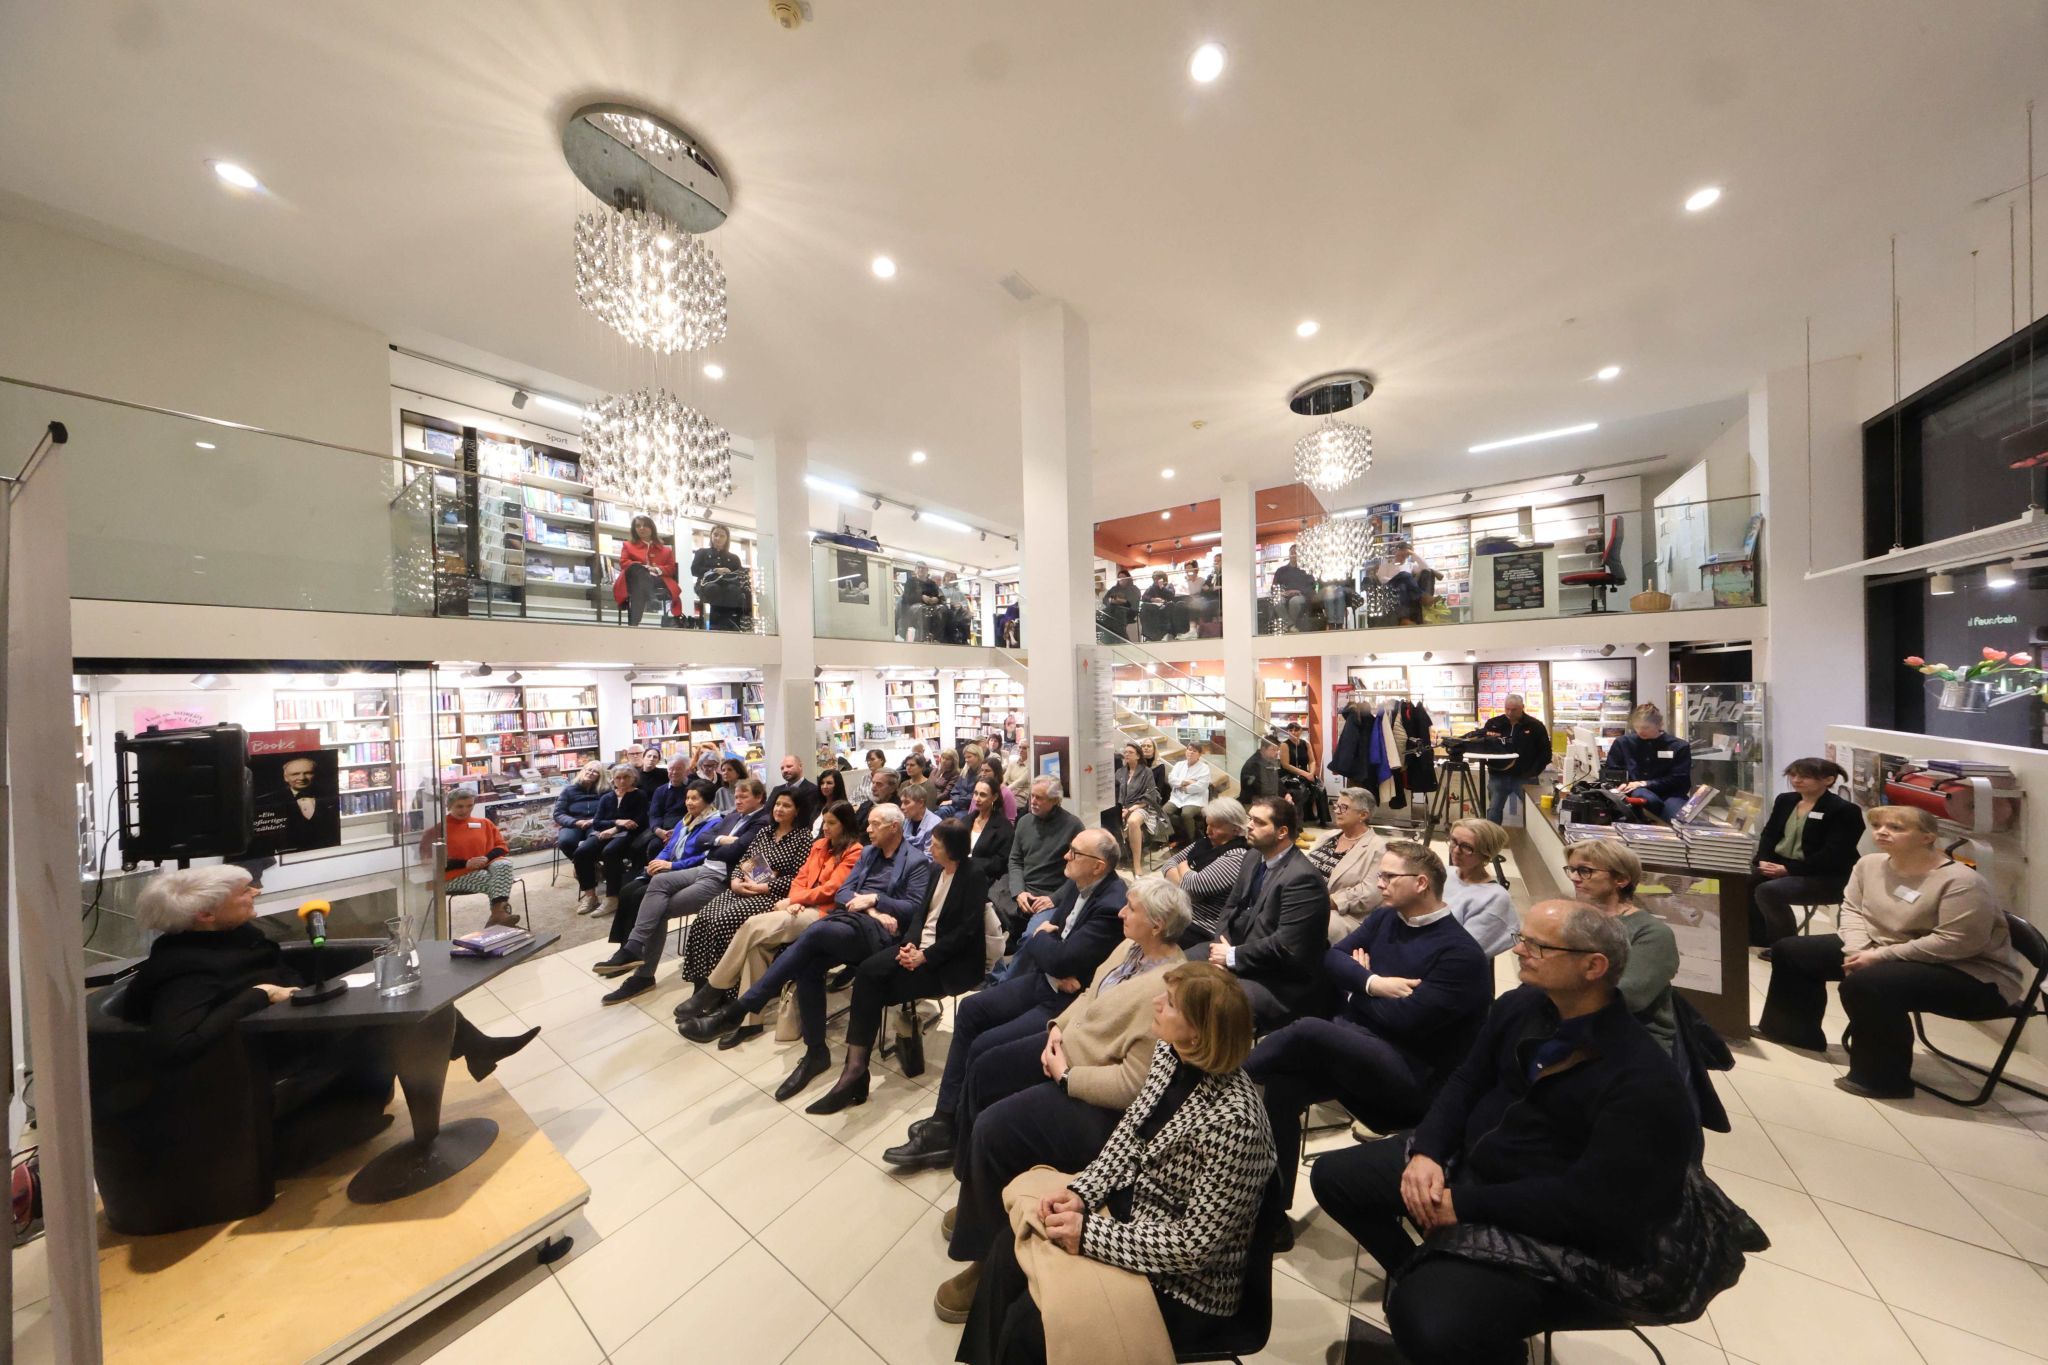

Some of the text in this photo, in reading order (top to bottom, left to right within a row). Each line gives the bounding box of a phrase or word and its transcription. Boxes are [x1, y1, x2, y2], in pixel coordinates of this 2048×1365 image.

[546, 431, 568, 444] Sport
[251, 739, 296, 752] Books
[253, 817, 288, 826] oßartiger
